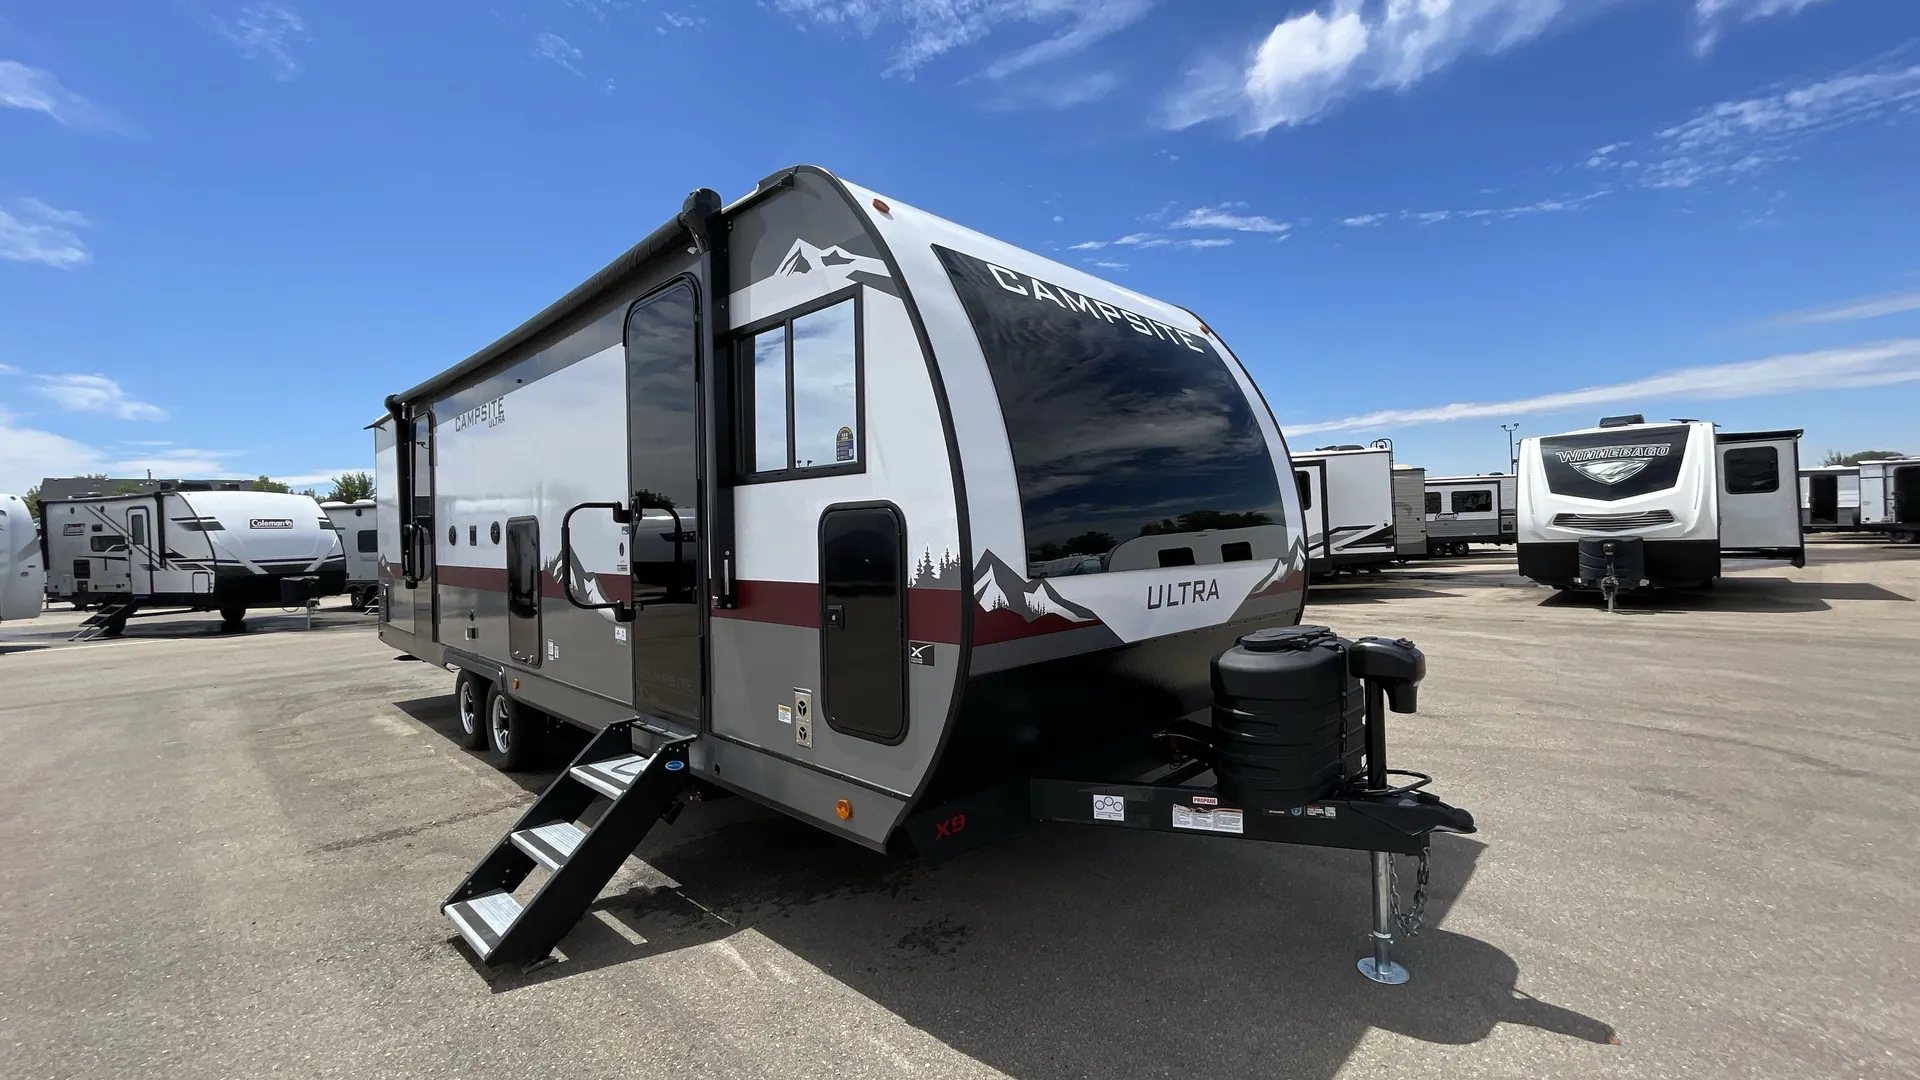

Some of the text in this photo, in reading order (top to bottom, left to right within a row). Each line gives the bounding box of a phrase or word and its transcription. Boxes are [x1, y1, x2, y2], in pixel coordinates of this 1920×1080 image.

[986, 263, 1204, 353] CAMPSITE
[455, 396, 504, 432] CAMPSITE
[489, 414, 505, 428] ULTRA
[1556, 445, 1670, 463] WINNEBAGO
[251, 519, 285, 527] Coleman
[1147, 578, 1220, 610] ULTRA
[935, 814, 966, 840] X9
